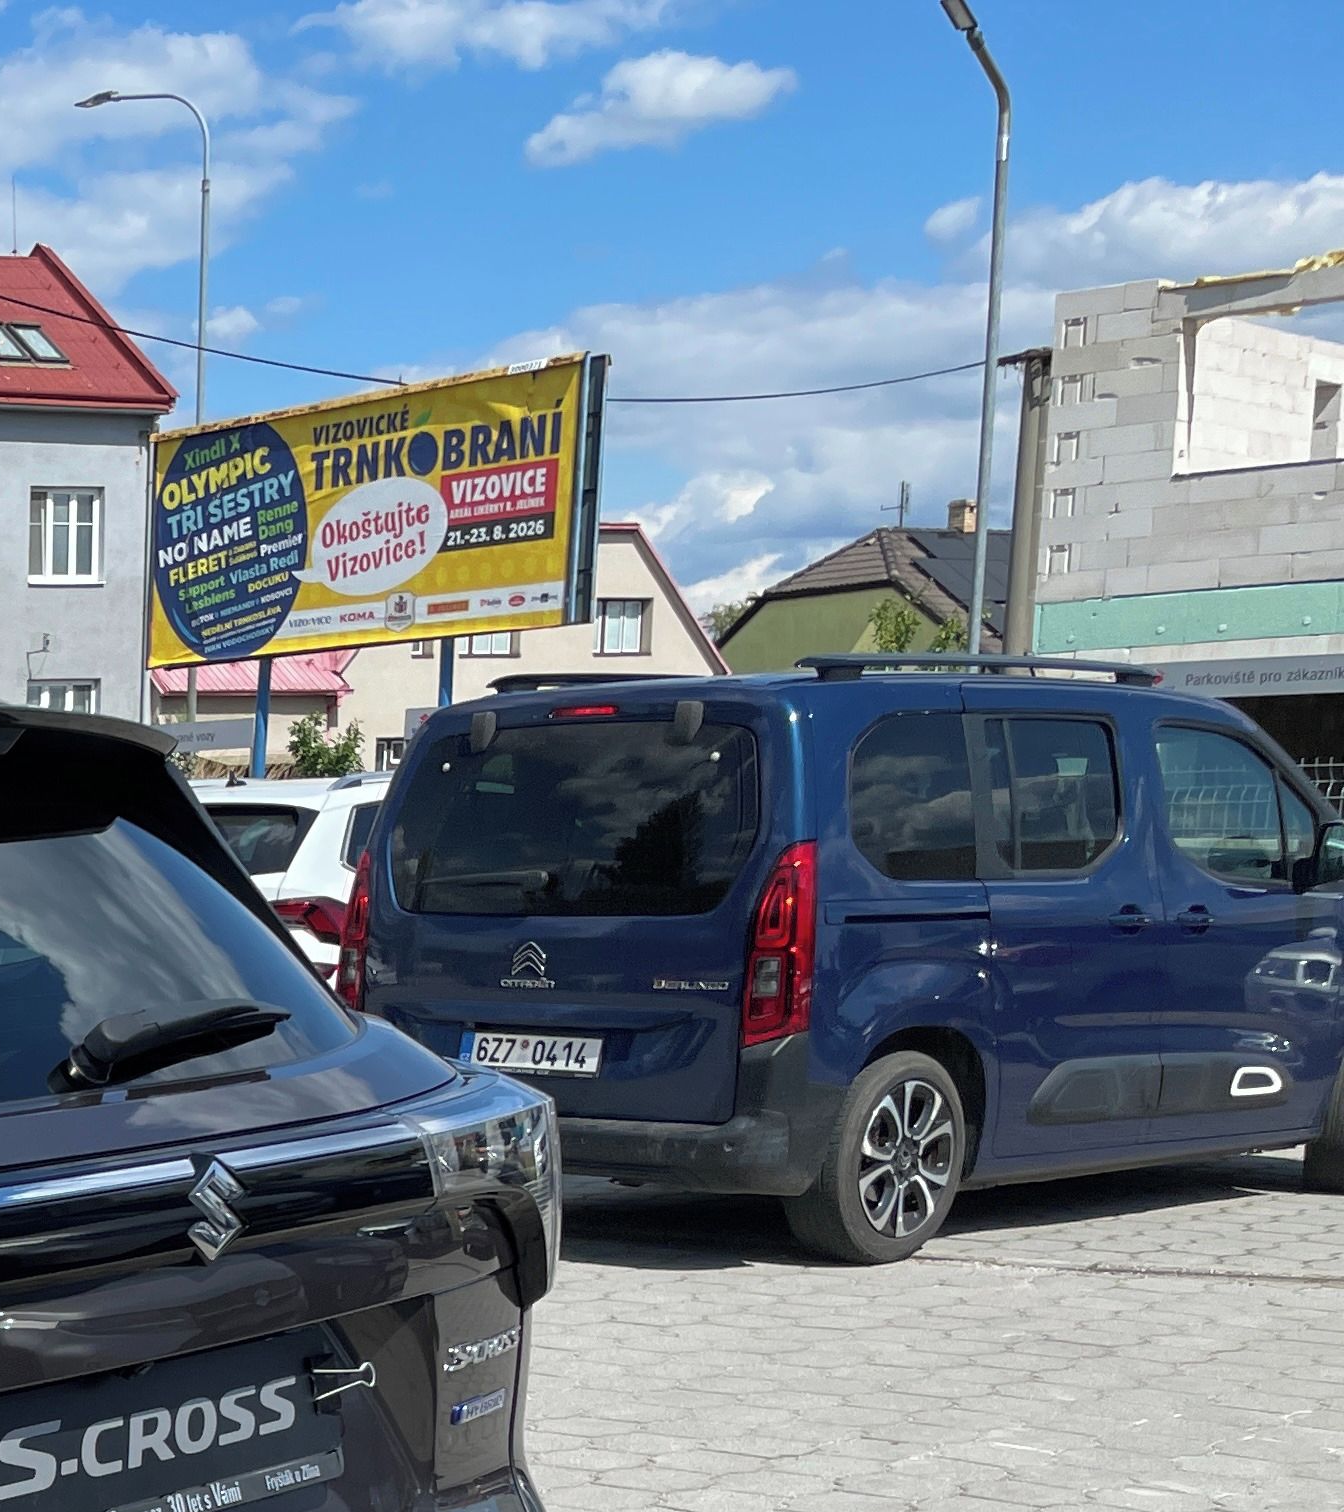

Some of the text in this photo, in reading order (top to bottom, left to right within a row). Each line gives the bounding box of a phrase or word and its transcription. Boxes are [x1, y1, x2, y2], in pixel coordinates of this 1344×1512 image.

[313, 403, 410, 446] VIZOVICKÉ
[183, 432, 241, 471] Xindl X
[162, 446, 272, 511] OLYMPIC
[451, 467, 547, 504] VIZOVICE
[167, 470, 295, 539] TŘI SESTRY
[257, 501, 299, 525] Renne
[158, 541, 188, 568] NO
[193, 516, 253, 555] NAME
[259, 519, 294, 540] Dang
[321, 501, 430, 549] Okoštujte
[493, 525, 506, 540] 8.
[509, 519, 545, 538] 2026
[260, 532, 304, 557] Premier
[327, 530, 426, 582] Vizovice!
[169, 550, 227, 586] FLERET
[229, 563, 268, 585] Vlasta
[269, 549, 299, 571] Redl
[247, 571, 290, 593] DOCUKU
[339, 611, 375, 623] KOMA
[1185, 670, 1255, 687] Parkoviště
[1259, 672, 1282, 686] pro
[476, 1037, 518, 1063] 6Z7
[532, 1040, 587, 1068] 0414
[204, 1493, 213, 1510] s
[209, 1480, 243, 1508] Vámi
